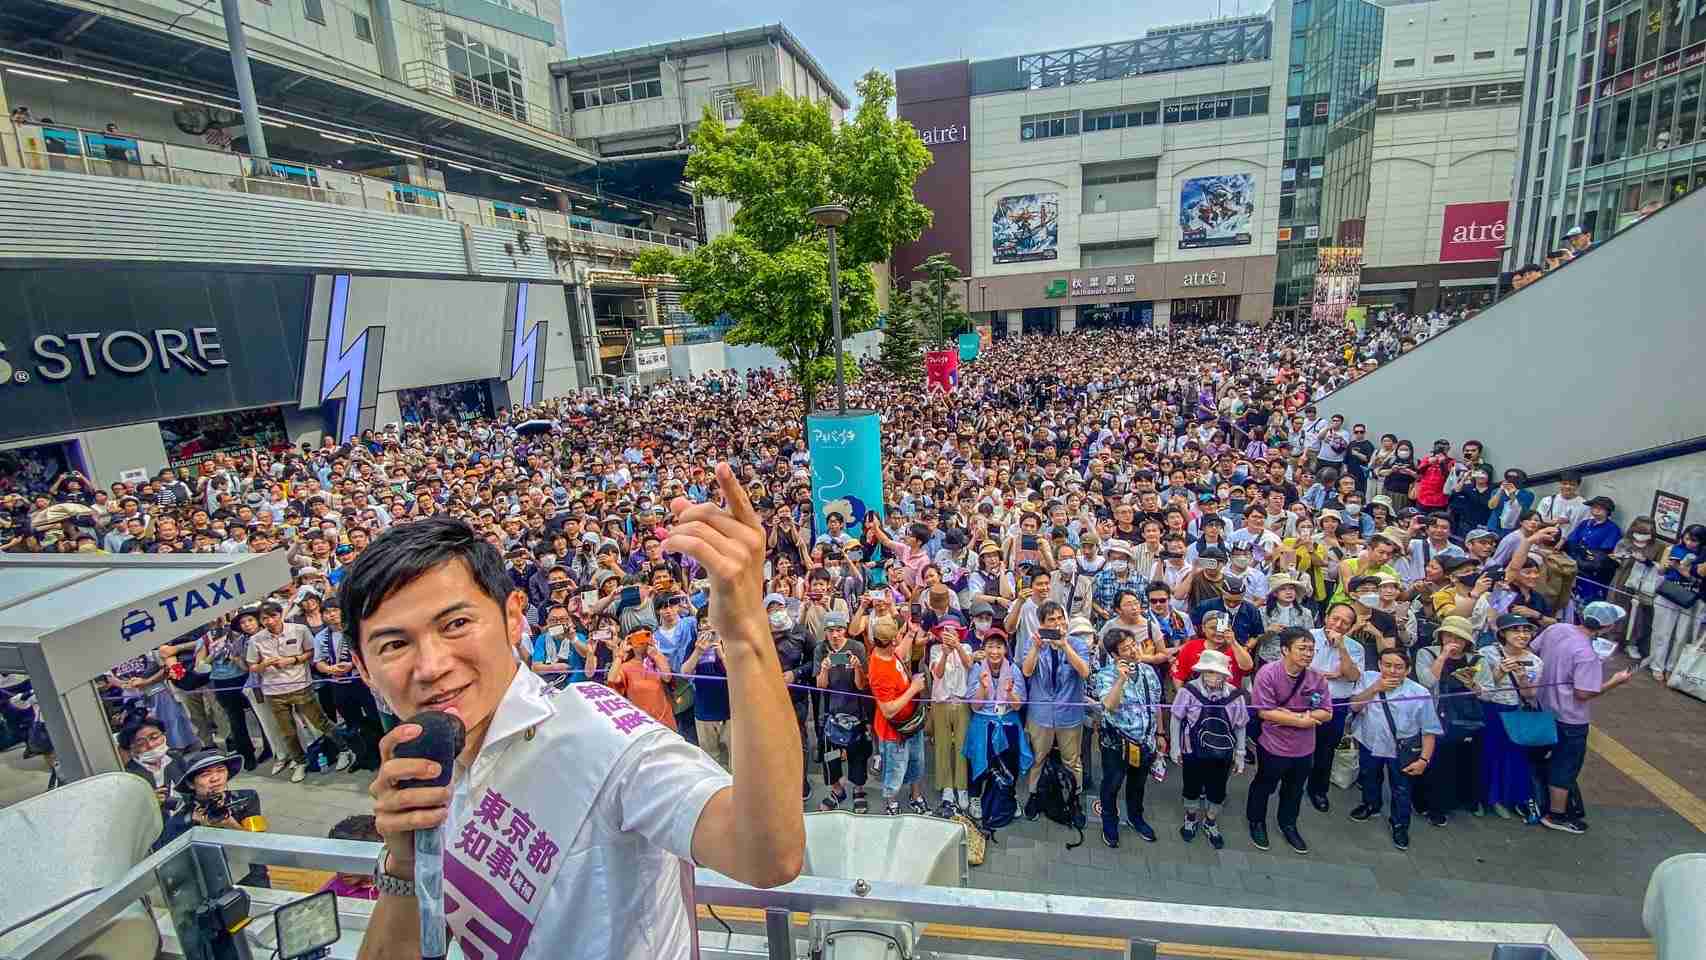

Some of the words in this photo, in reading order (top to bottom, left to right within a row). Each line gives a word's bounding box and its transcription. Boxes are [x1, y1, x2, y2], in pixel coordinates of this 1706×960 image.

[922, 124, 959, 144] atré
[1453, 219, 1505, 243] atré
[1183, 270, 1217, 287] atré
[34, 327, 230, 380] STORE
[159, 572, 247, 623] TAXI
[473, 787, 560, 875] 東京都
